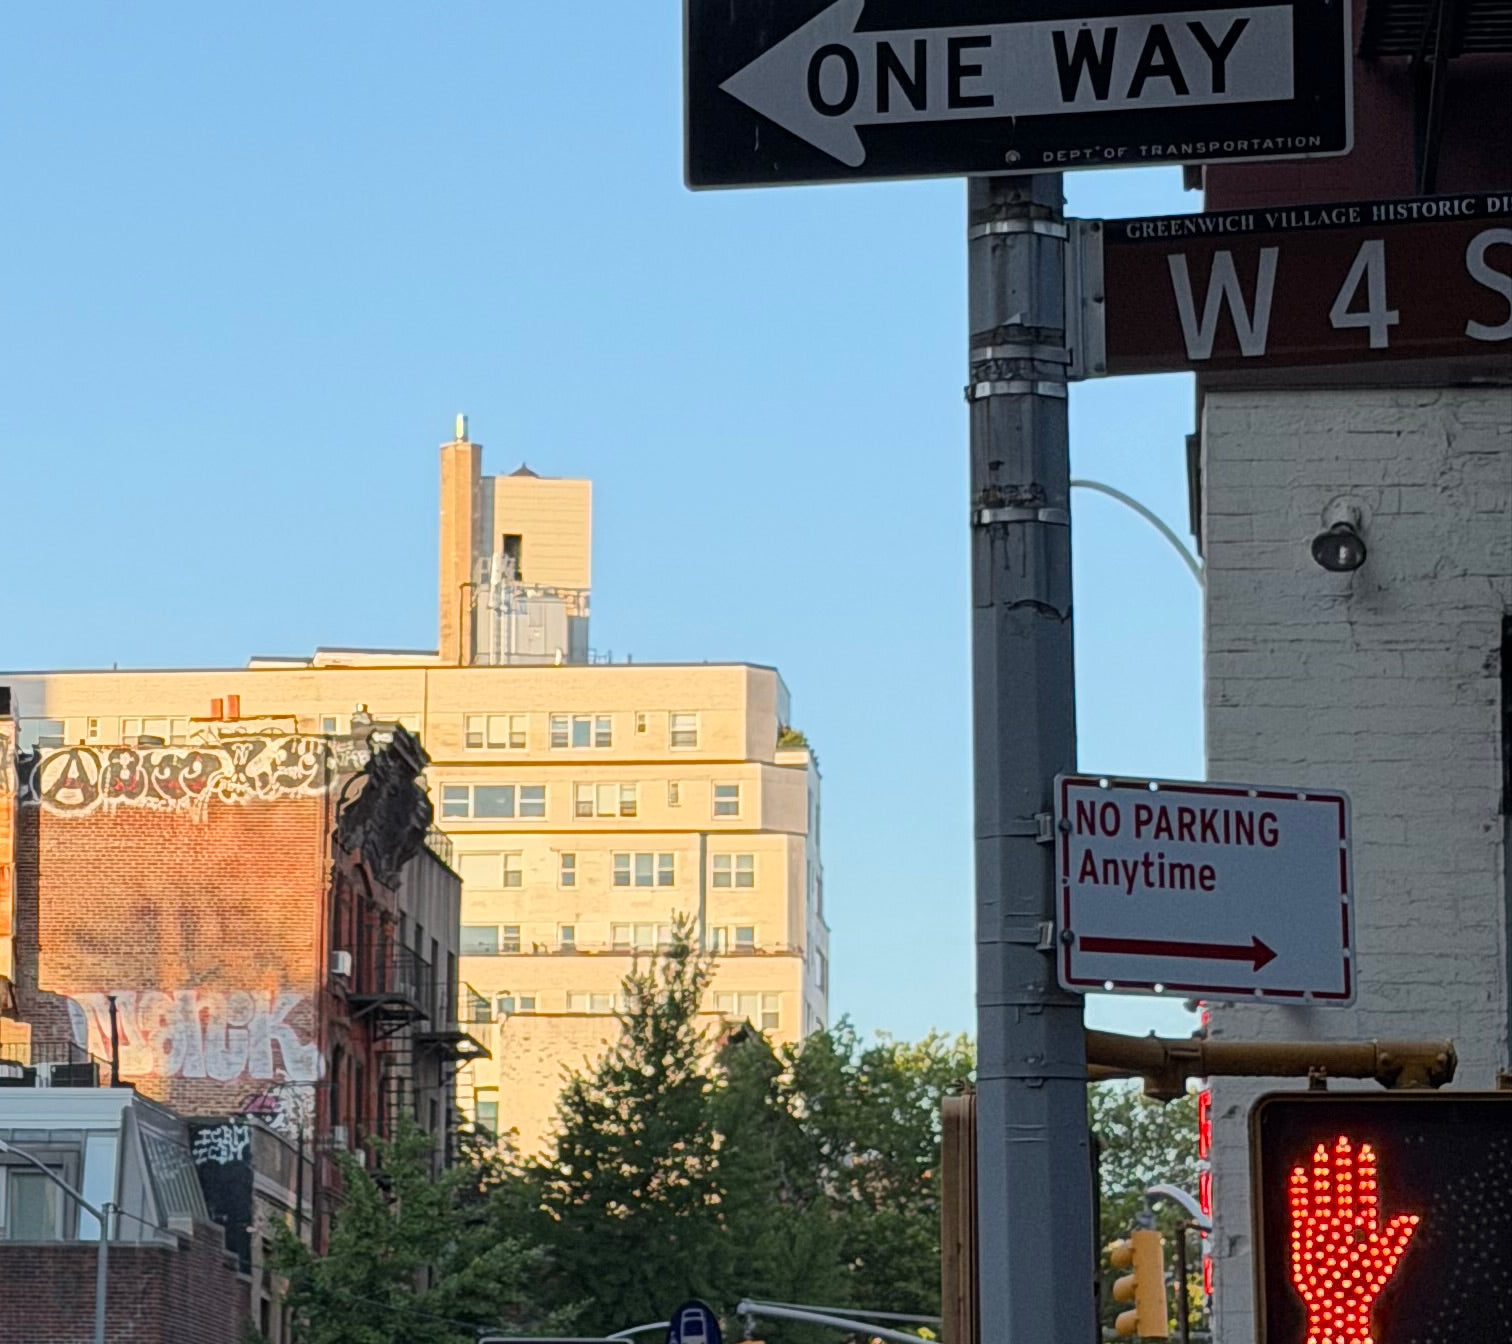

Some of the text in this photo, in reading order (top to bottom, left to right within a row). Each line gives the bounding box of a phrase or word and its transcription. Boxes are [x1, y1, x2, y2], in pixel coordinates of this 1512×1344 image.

[805, 17, 1250, 117] ONE WAY
[1103, 146, 1126, 159] OF
[1139, 135, 1322, 157] TRANSPORTATION
[1125, 214, 1255, 239] GREENWICH
[1265, 207, 1361, 228] VILLAGE
[1372, 198, 1476, 221] HISTORIC
[1168, 246, 1279, 360] W
[1329, 239, 1399, 348] 4
[1075, 800, 1280, 847] NO PARKING
[1078, 849, 1216, 895] Anytime
